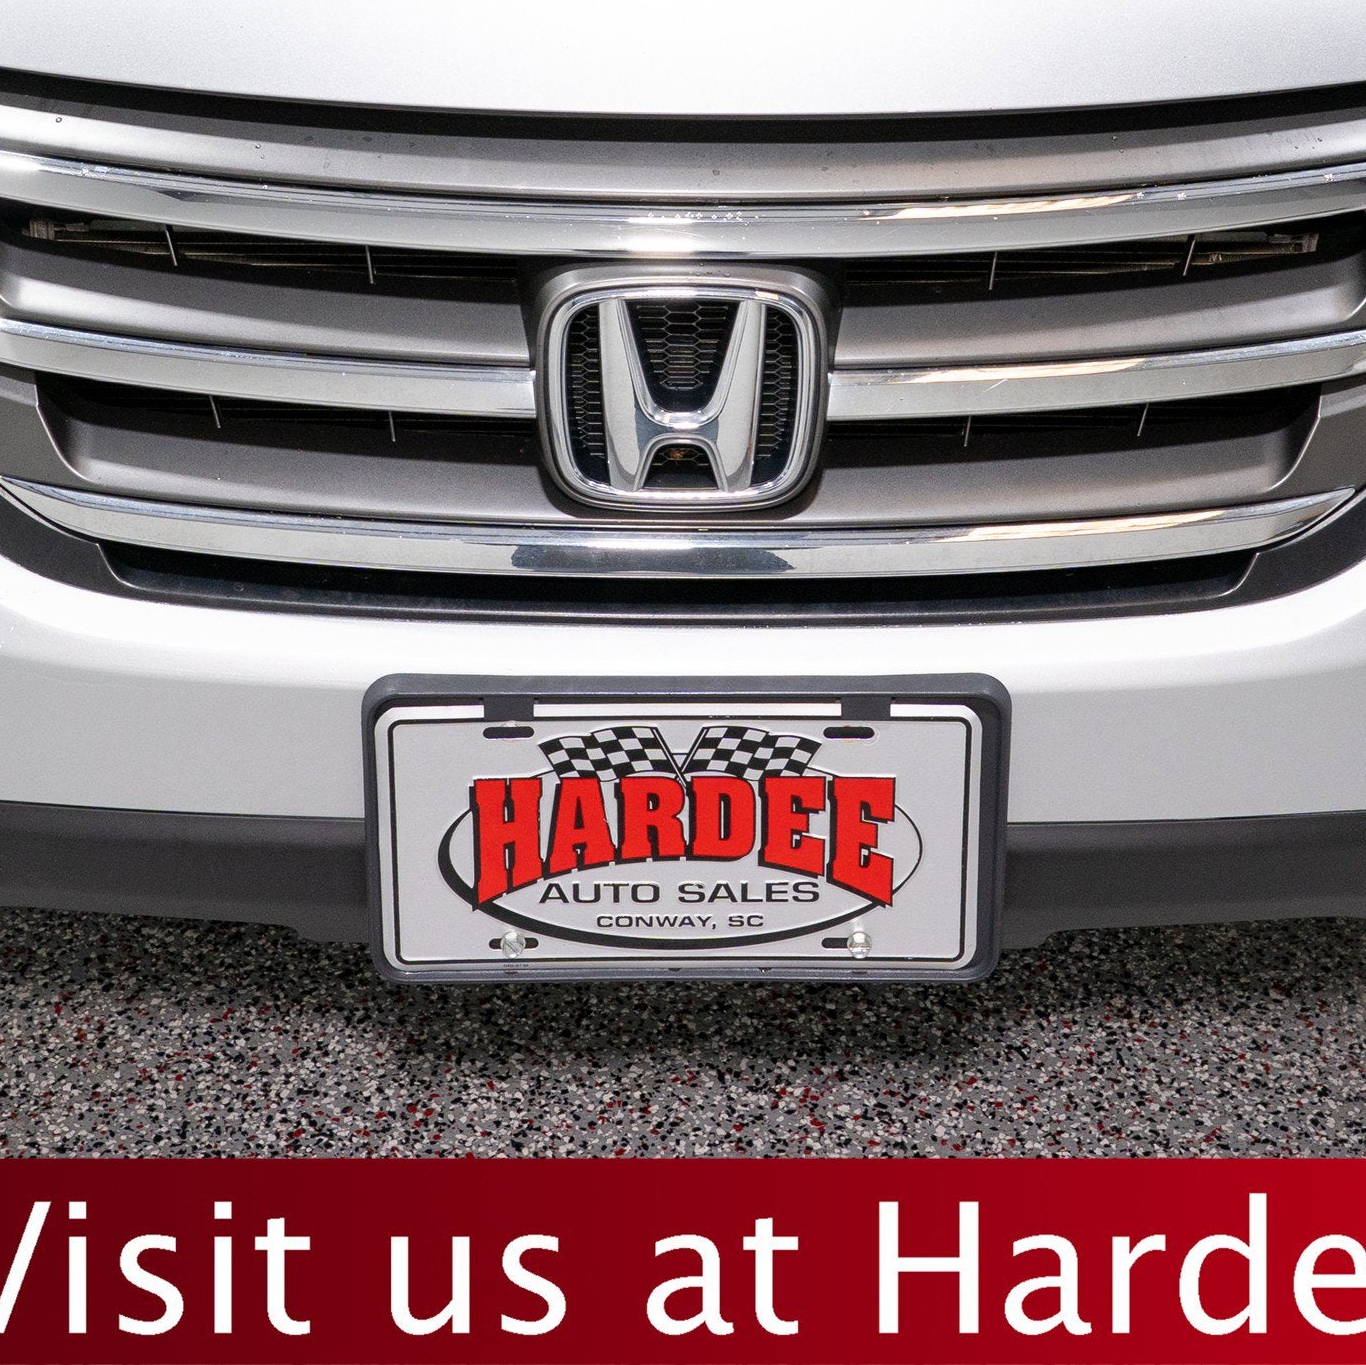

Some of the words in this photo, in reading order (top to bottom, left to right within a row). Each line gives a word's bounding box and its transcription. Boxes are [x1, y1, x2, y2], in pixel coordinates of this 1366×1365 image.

[597, 295, 767, 493] H
[469, 774, 898, 911] HARDEE
[539, 882, 661, 904] AUTO
[677, 881, 820, 904] SALES
[596, 914, 717, 930] CONWAY,
[728, 914, 765, 928] SC
